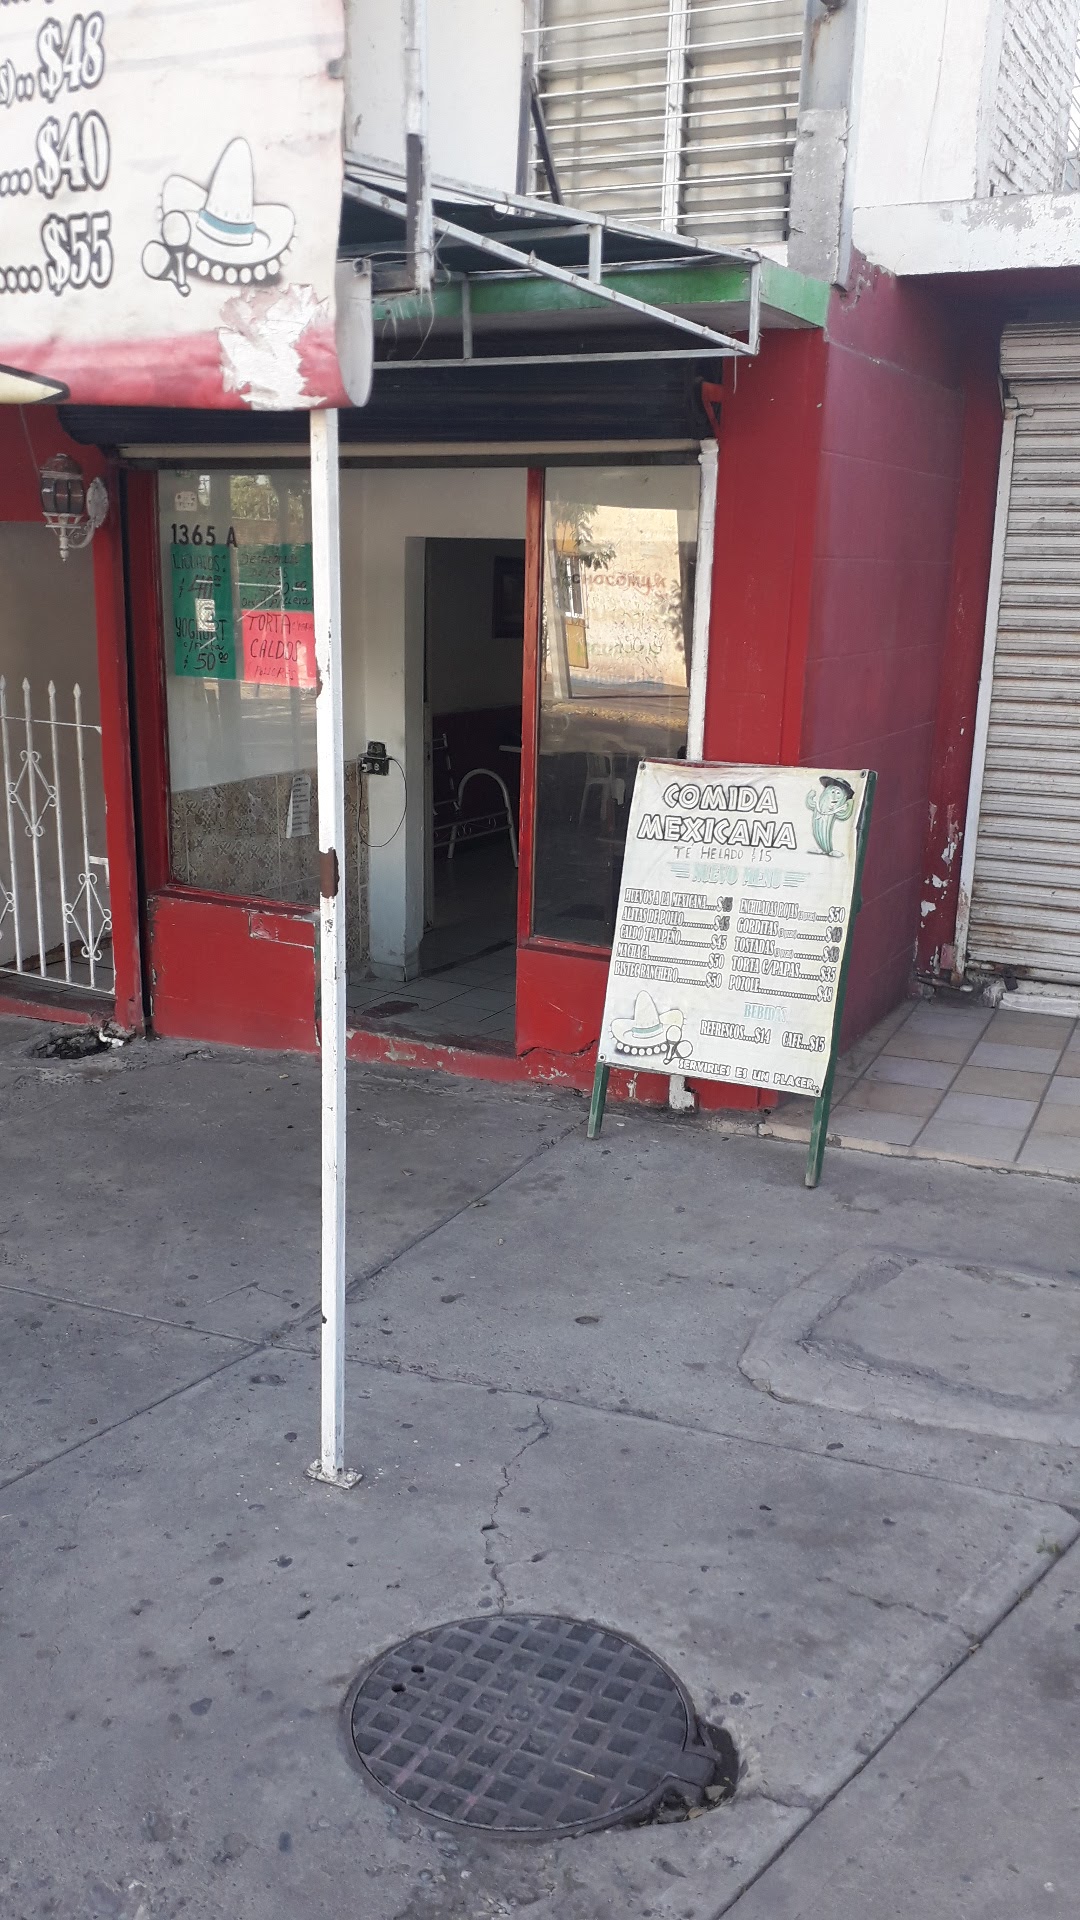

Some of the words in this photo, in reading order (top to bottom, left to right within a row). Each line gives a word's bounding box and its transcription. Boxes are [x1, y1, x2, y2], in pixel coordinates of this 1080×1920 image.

[36, 11, 105, 103] $48
[35, 109, 110, 199] $40
[41, 211, 114, 296] $55
[171, 523, 216, 546] 1365
[226, 527, 238, 548] A
[247, 612, 291, 635] TORTA
[250, 638, 302, 662] CALDOS
[663, 782, 778, 813] COMIDA
[637, 814, 797, 850] MEXICANA
[701, 846, 744, 860] HELADO
[692, 863, 739, 885] NUEVO
[625, 888, 653, 905] HUEVOS
[653, 890, 660, 905] A
[660, 891, 670, 906] LA
[622, 906, 648, 923] ALITAS
[648, 909, 659, 924] DE
[620, 924, 644, 941] CALDO
[737, 917, 779, 937] GORDITAS
[734, 936, 775, 956] TOSTADAS
[614, 960, 639, 978] BISTEC
[732, 955, 760, 974] TORTA
[743, 1002, 787, 1023] BEBIDAS
[678, 1056, 732, 1076] SERVIRLES
[735, 1066, 748, 1080] ES
[752, 1070, 770, 1082] UN
